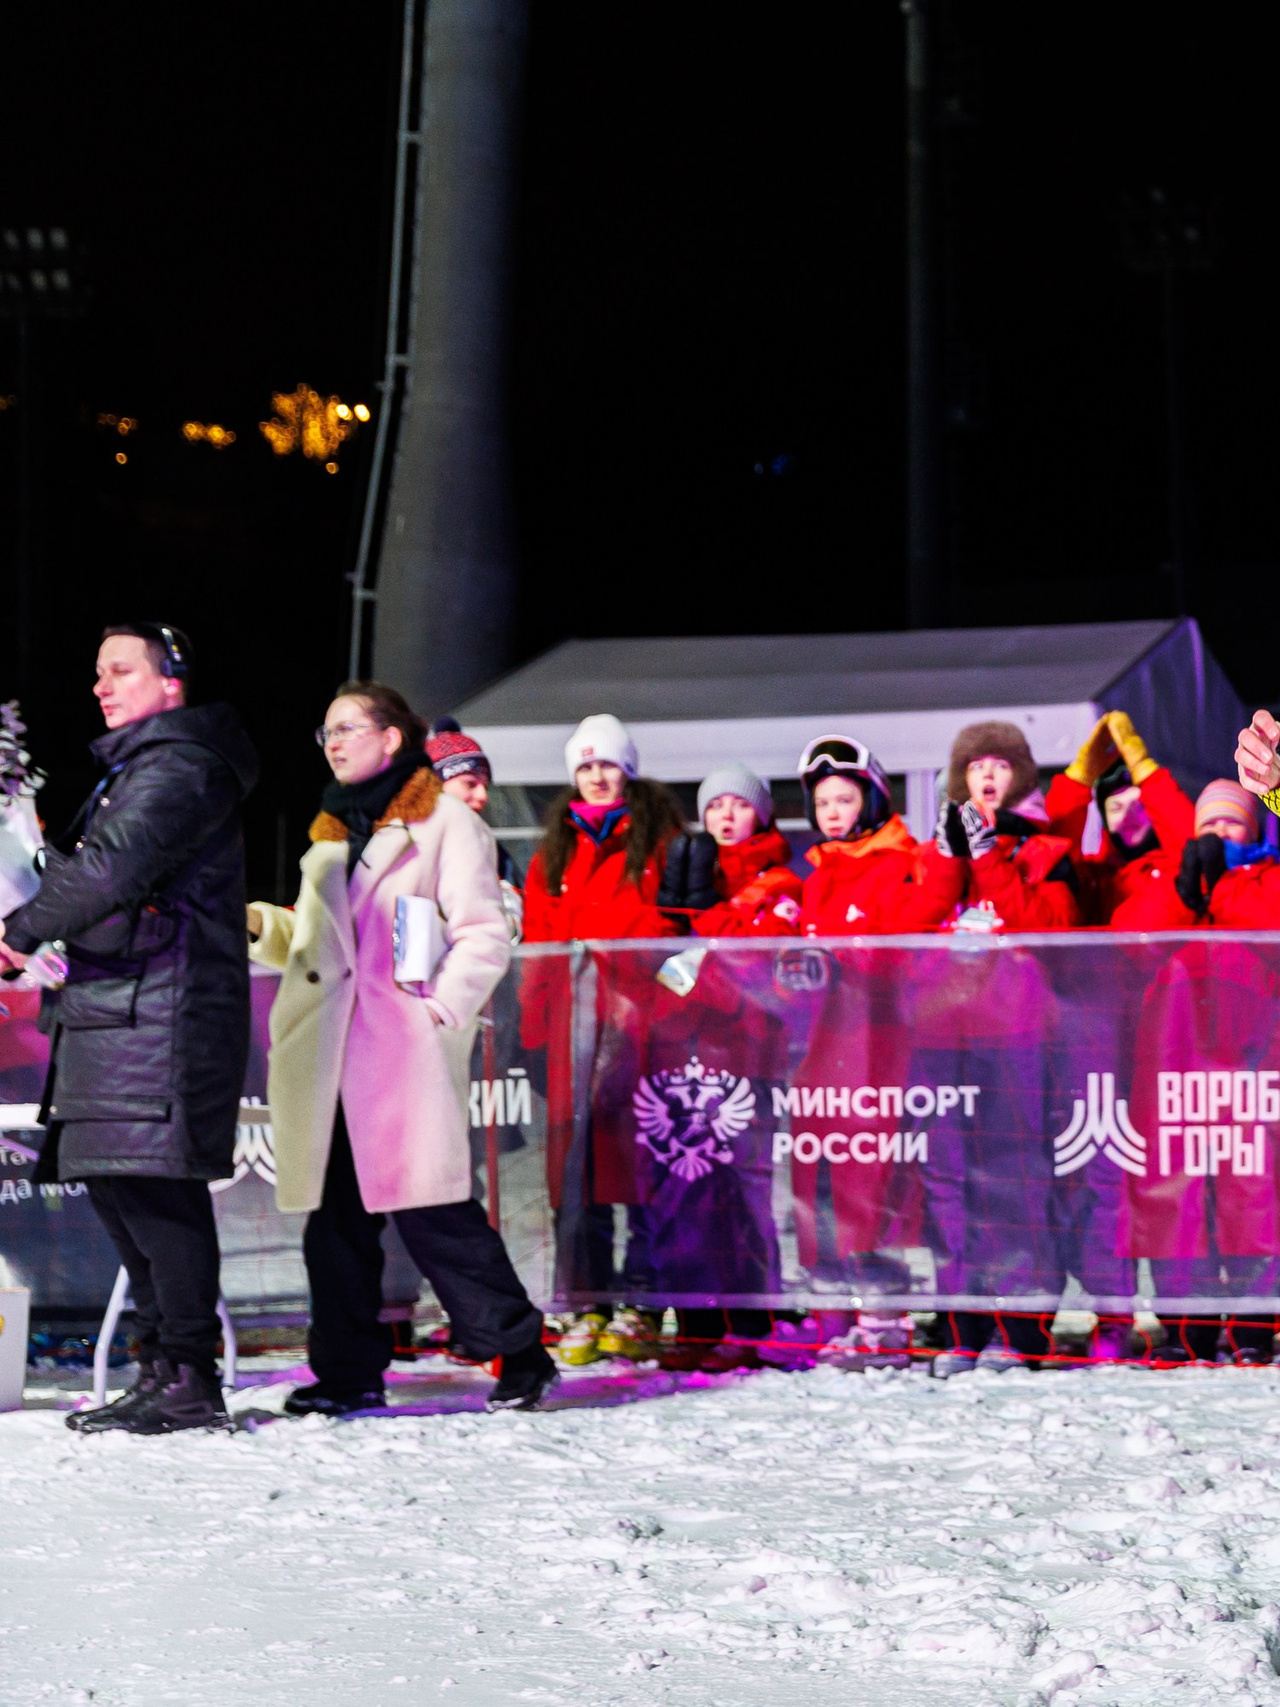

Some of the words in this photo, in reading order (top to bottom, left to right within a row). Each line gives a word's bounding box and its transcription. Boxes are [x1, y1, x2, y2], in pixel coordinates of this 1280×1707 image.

[771, 1085, 981, 1118] МИНСПОРТ
[772, 1131, 928, 1164] РОССИИ
[1158, 1124, 1266, 1177] ГОРЫ
